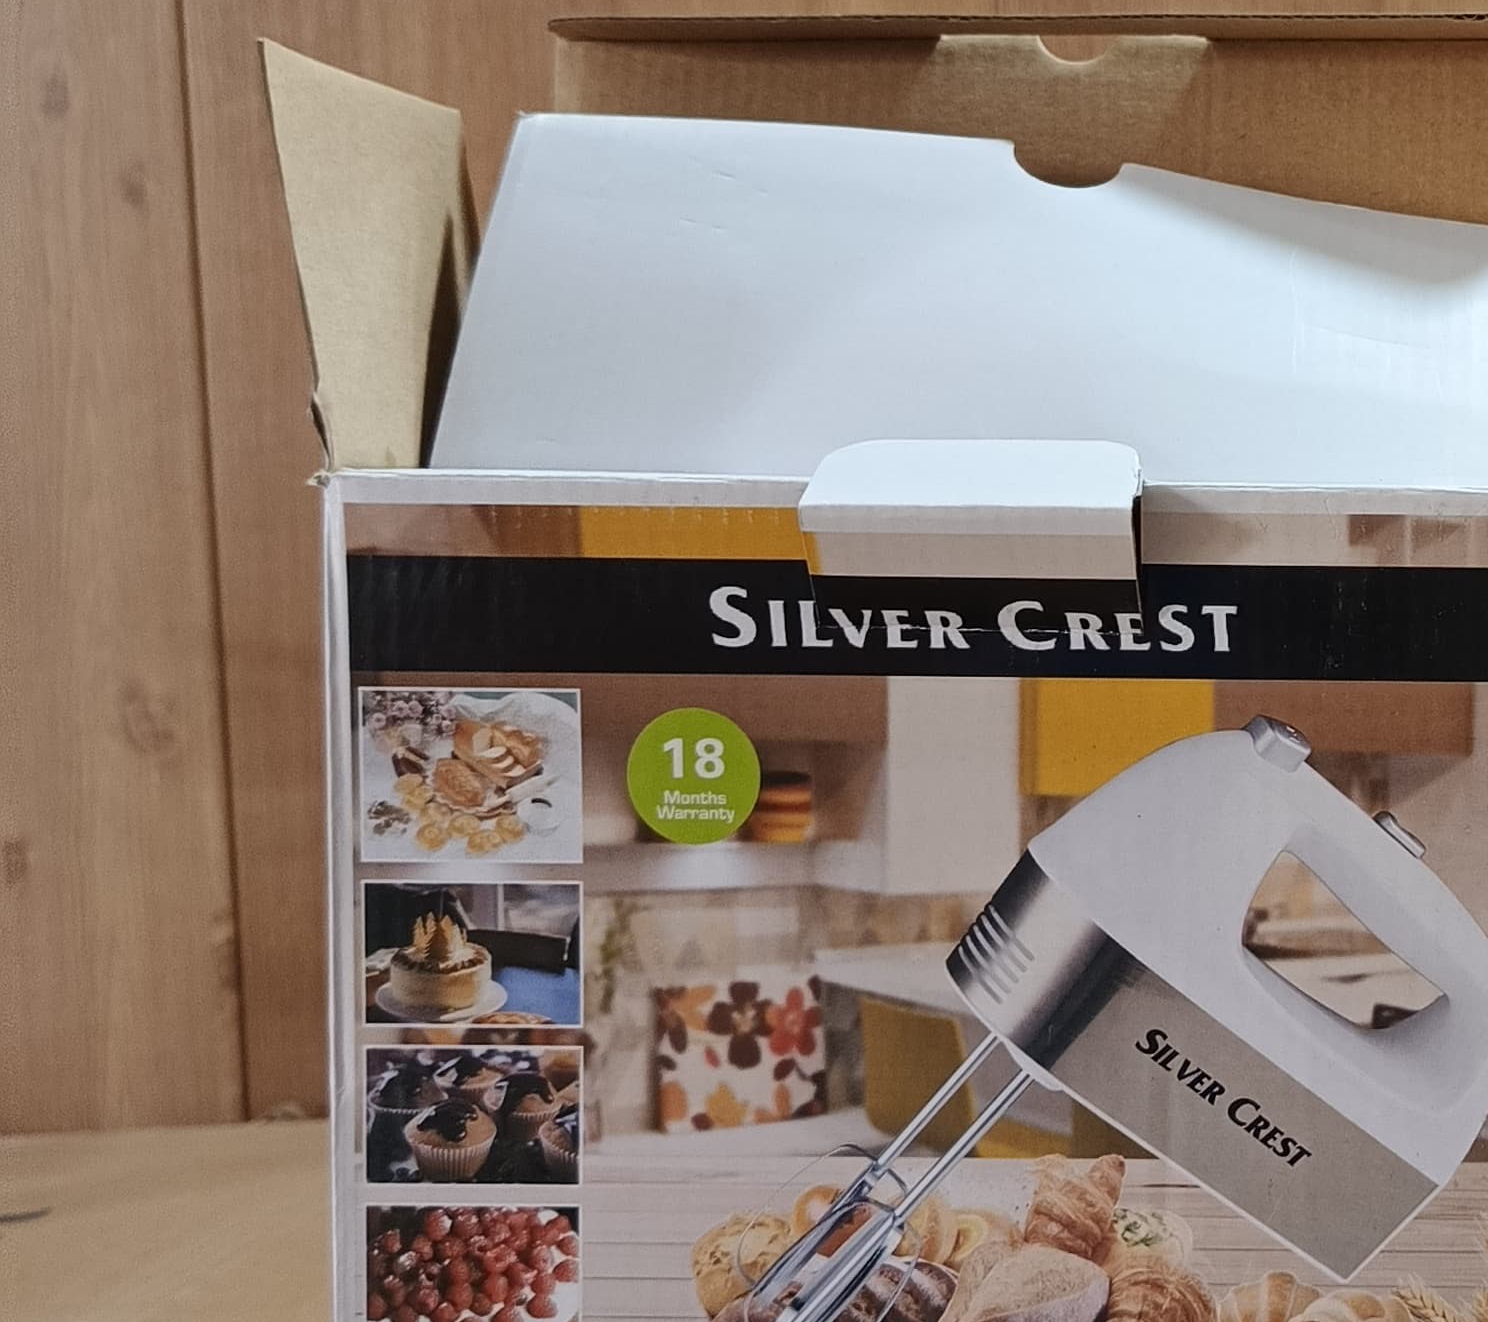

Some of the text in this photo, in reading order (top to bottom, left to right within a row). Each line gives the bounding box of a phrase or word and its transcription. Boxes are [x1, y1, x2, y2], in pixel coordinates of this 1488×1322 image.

[708, 585, 1238, 653] SILVER CREST
[663, 737, 726, 779] 18
[656, 805, 735, 824] Warranty
[663, 790, 727, 805] Months
[1135, 1028, 1312, 1167] SILVER CREST
